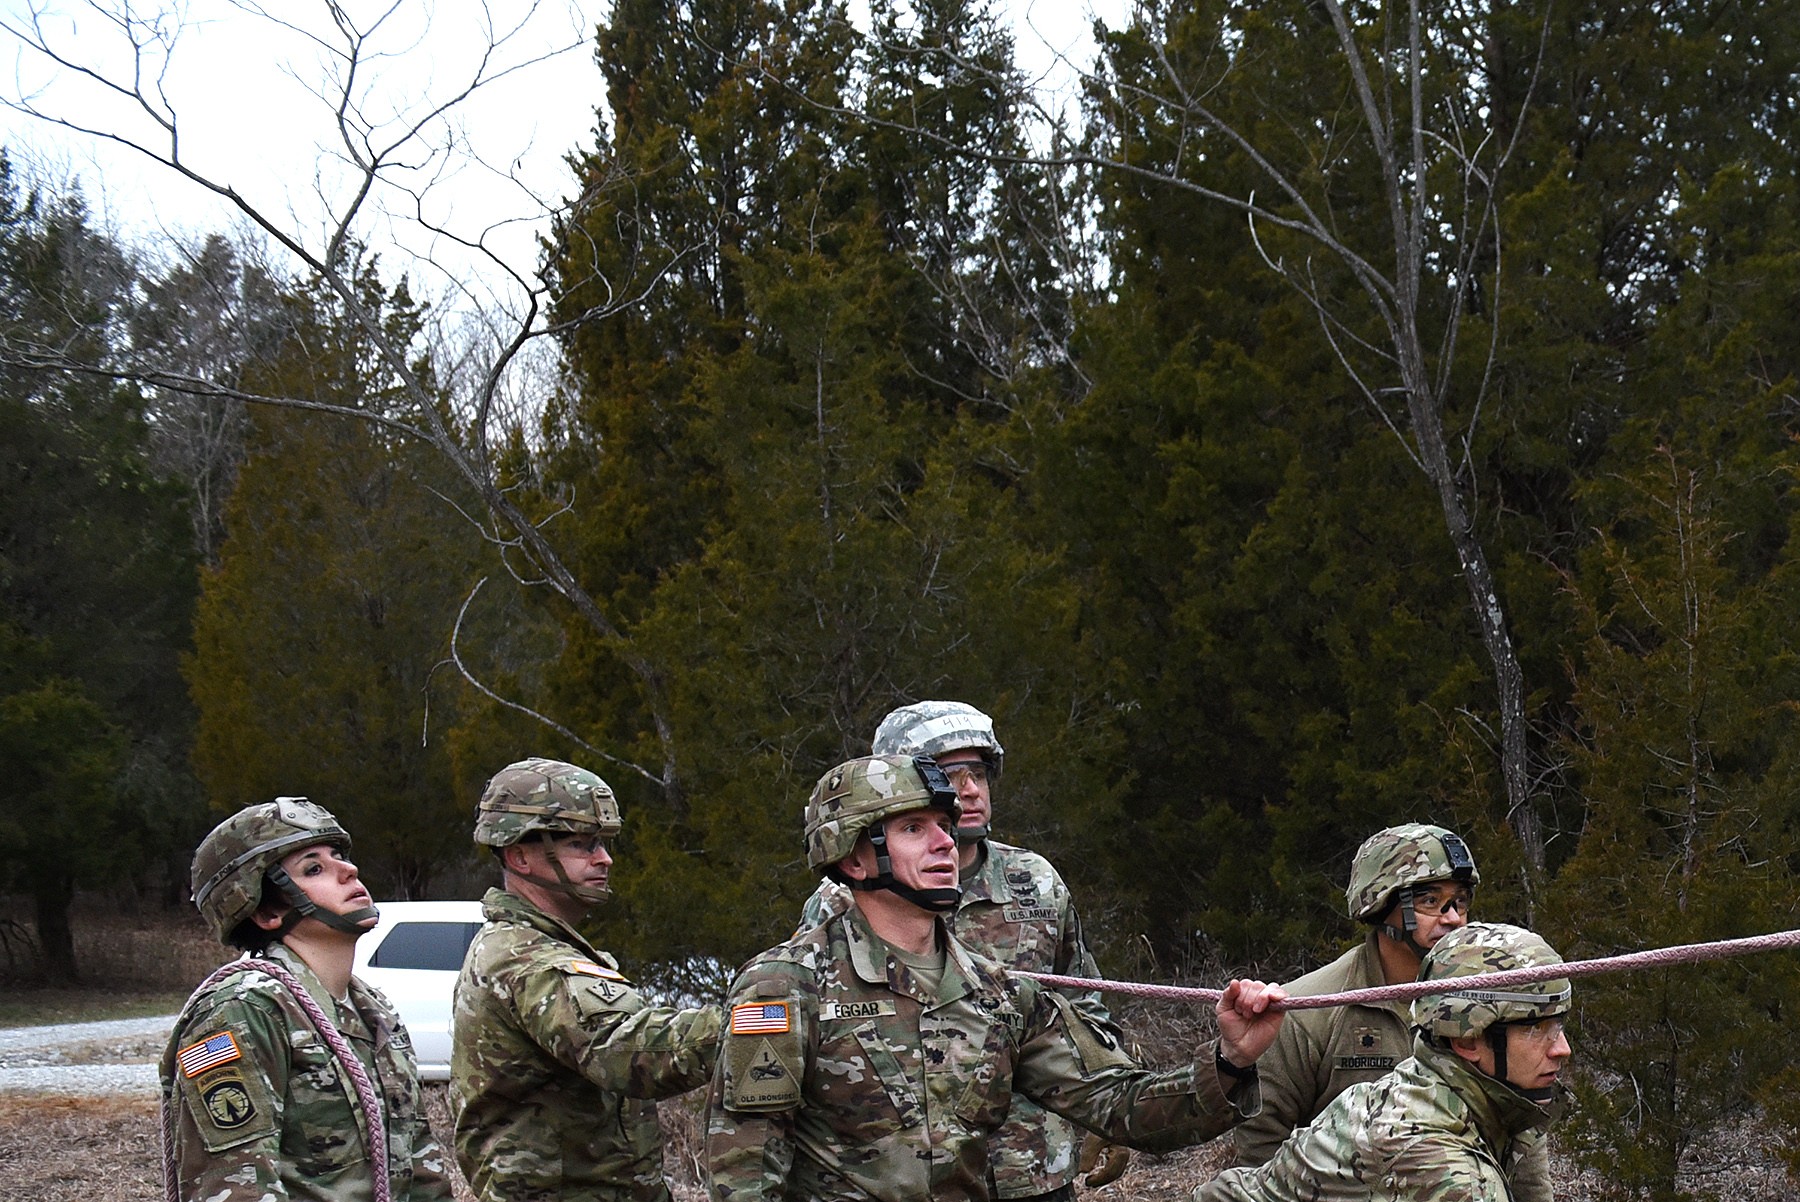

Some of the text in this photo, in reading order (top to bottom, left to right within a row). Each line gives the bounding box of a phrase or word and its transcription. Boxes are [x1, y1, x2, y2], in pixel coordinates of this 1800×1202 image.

[1029, 909, 1052, 920] ARMY
[1340, 1057, 1394, 1068] RODRIGUEZ
[740, 1095, 756, 1103] OLD
